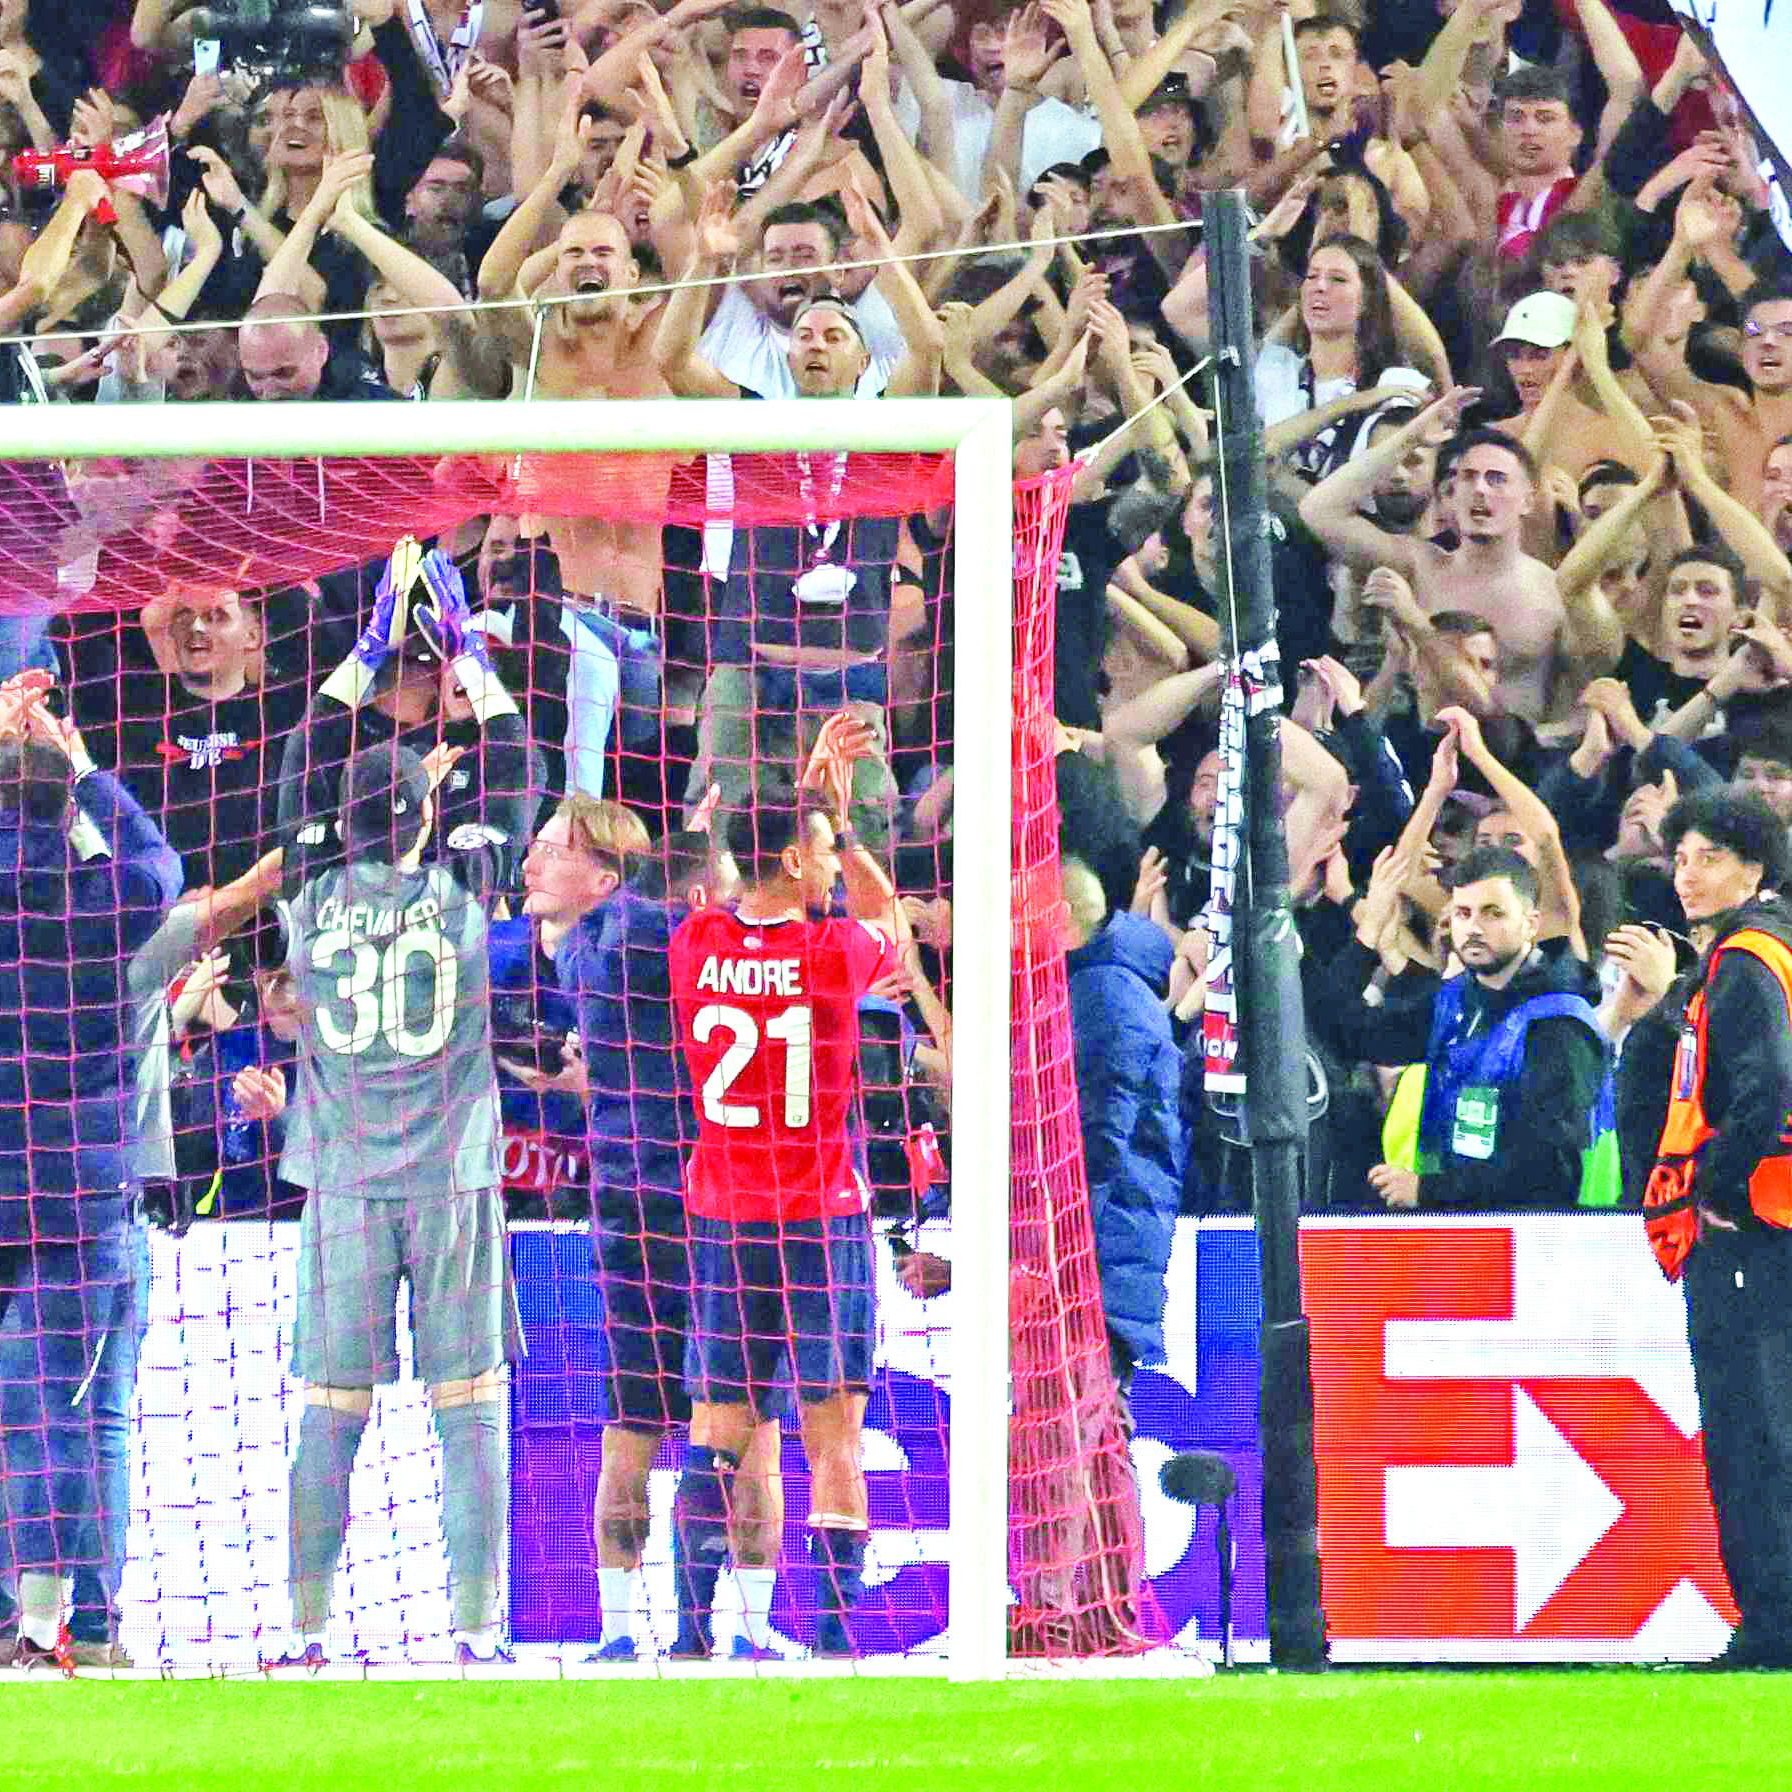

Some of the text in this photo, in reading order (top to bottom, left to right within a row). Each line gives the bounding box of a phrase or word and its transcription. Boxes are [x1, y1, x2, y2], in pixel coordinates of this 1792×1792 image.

[311, 930, 457, 1056] 30
[697, 956, 803, 997] ANDRE
[693, 1005, 813, 1128] 21
